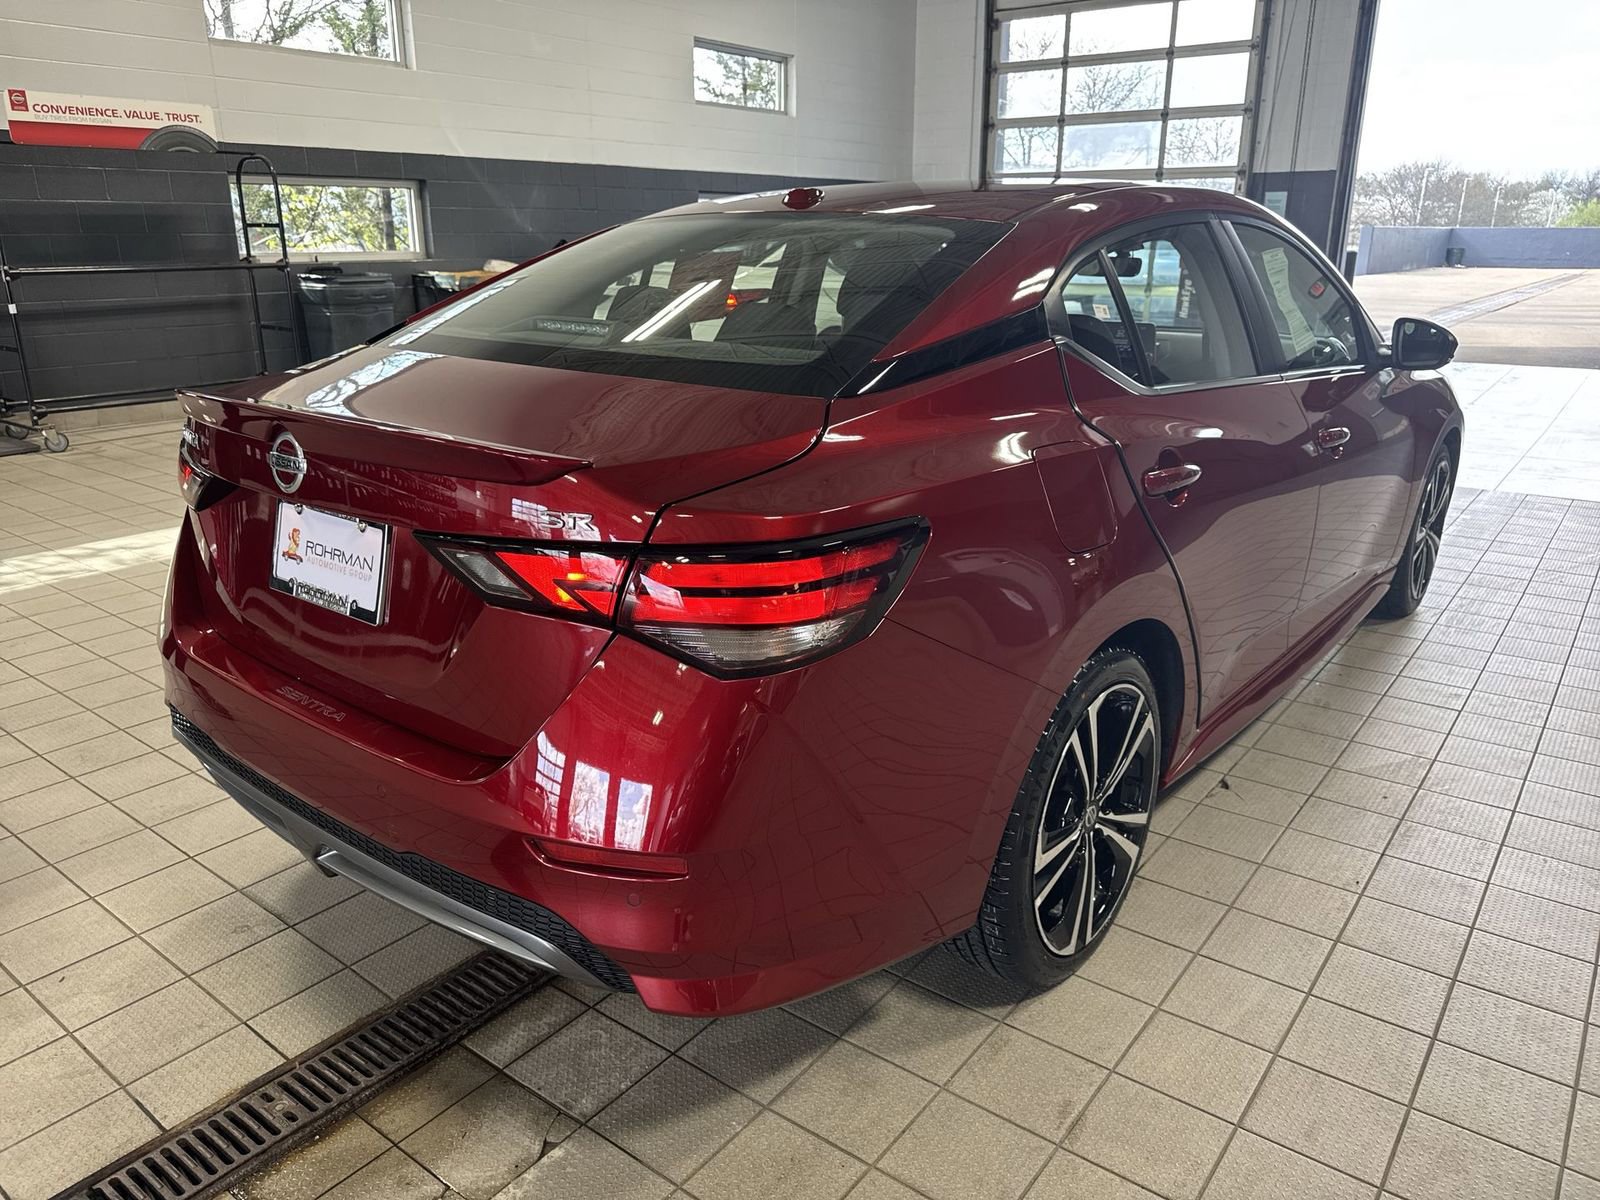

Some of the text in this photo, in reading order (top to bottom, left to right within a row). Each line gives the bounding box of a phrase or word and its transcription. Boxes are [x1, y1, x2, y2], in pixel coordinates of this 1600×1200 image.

[32, 103, 202, 124] CONVENIENCE. VALUE. TRUST.
[540, 510, 595, 531] SR
[305, 540, 374, 572] ROHRMAN
[306, 556, 373, 582] AUTOMOTIVE GROUP
[276, 686, 346, 722] SENTRA
